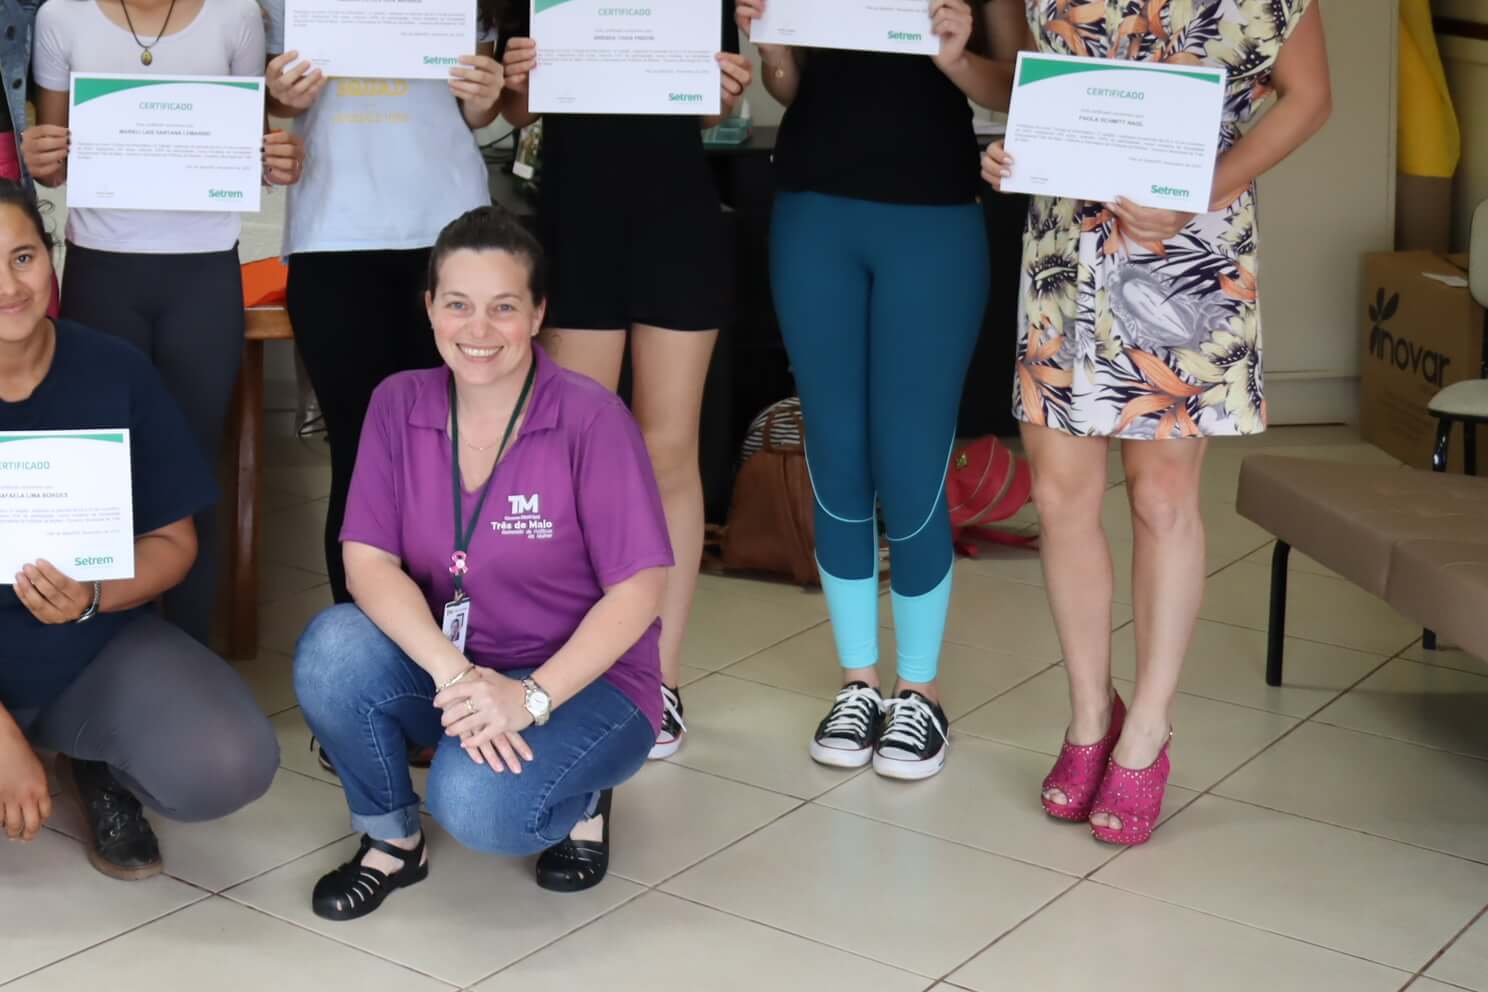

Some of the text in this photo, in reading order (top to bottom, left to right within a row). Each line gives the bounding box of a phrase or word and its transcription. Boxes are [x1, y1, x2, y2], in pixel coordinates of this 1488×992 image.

[597, 8, 652, 17] CERTIFICADO
[887, 30, 922, 41] Setrem
[423, 55, 458, 65] Setrem
[668, 92, 703, 102] Setrem
[1086, 87, 1145, 101] CERTIFICADO
[138, 102, 194, 111] CERTIFICADO
[208, 189, 244, 198] Setrem
[1150, 184, 1190, 198] Setrem
[508, 493, 538, 514] TM
[490, 519, 552, 531] Três de Maio
[74, 555, 114, 567] Setrem
